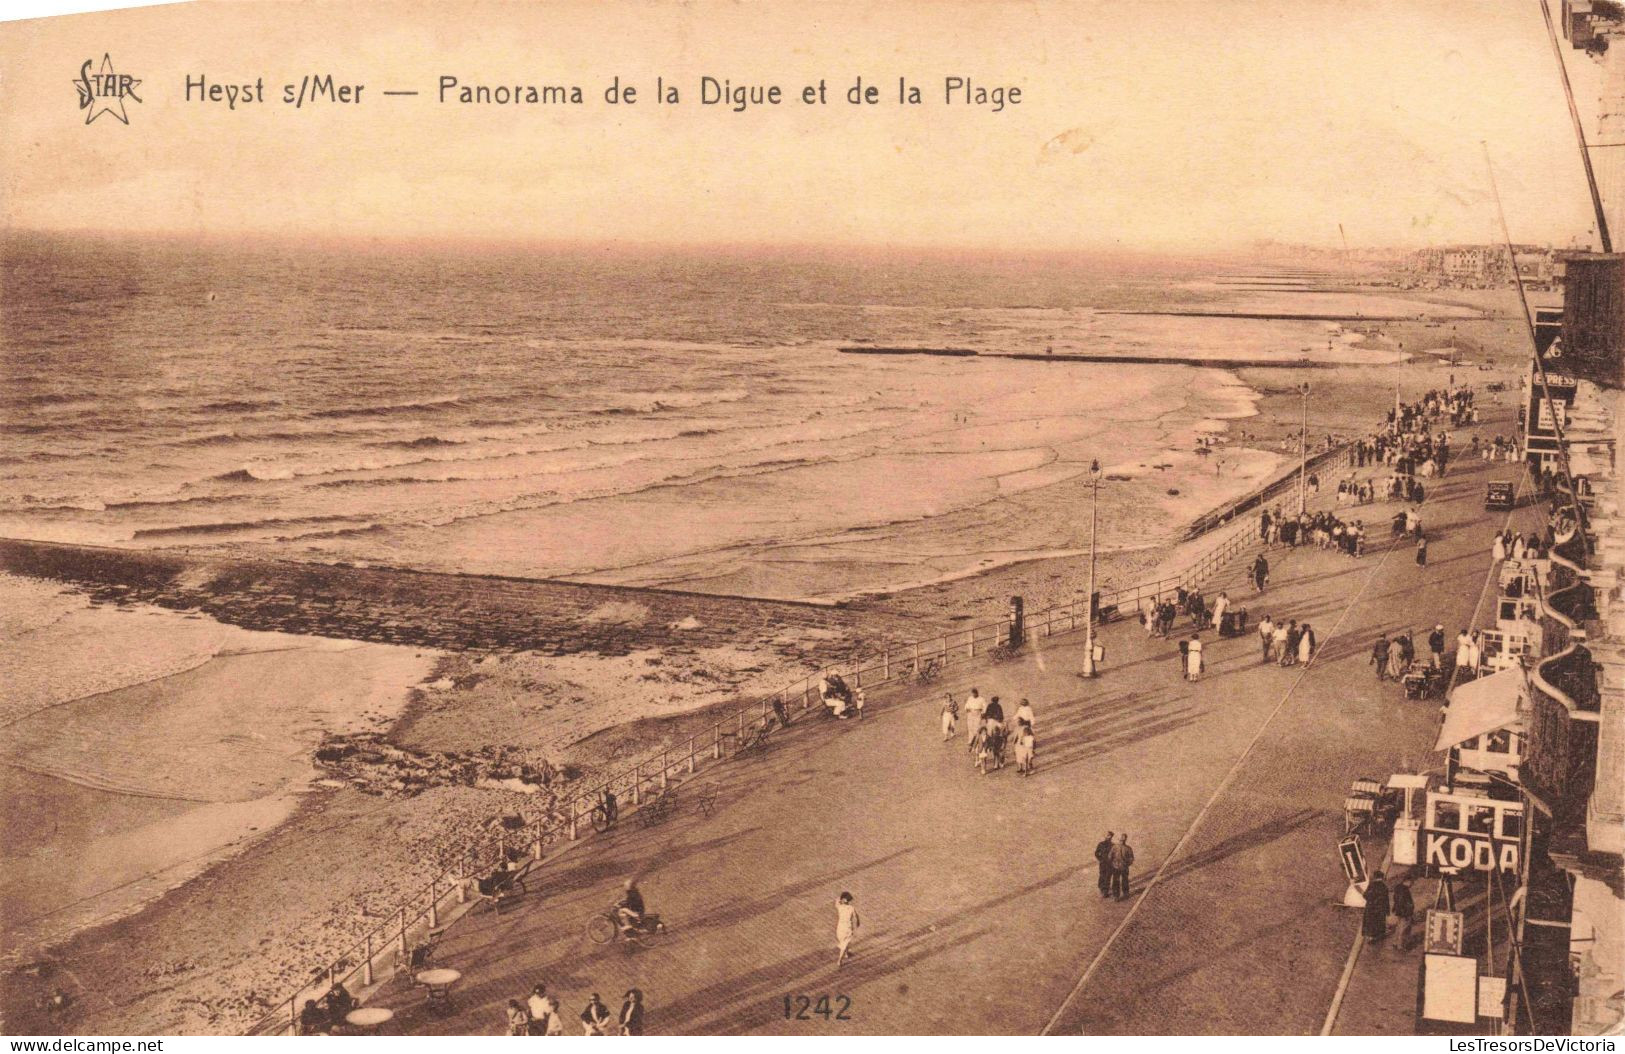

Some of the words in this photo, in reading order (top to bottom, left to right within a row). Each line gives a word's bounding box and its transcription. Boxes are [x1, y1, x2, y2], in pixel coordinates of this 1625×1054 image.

[76, 59, 142, 109] STAR
[1535, 374, 1575, 386] EPRESS
[1426, 833, 1519, 875] KODA
